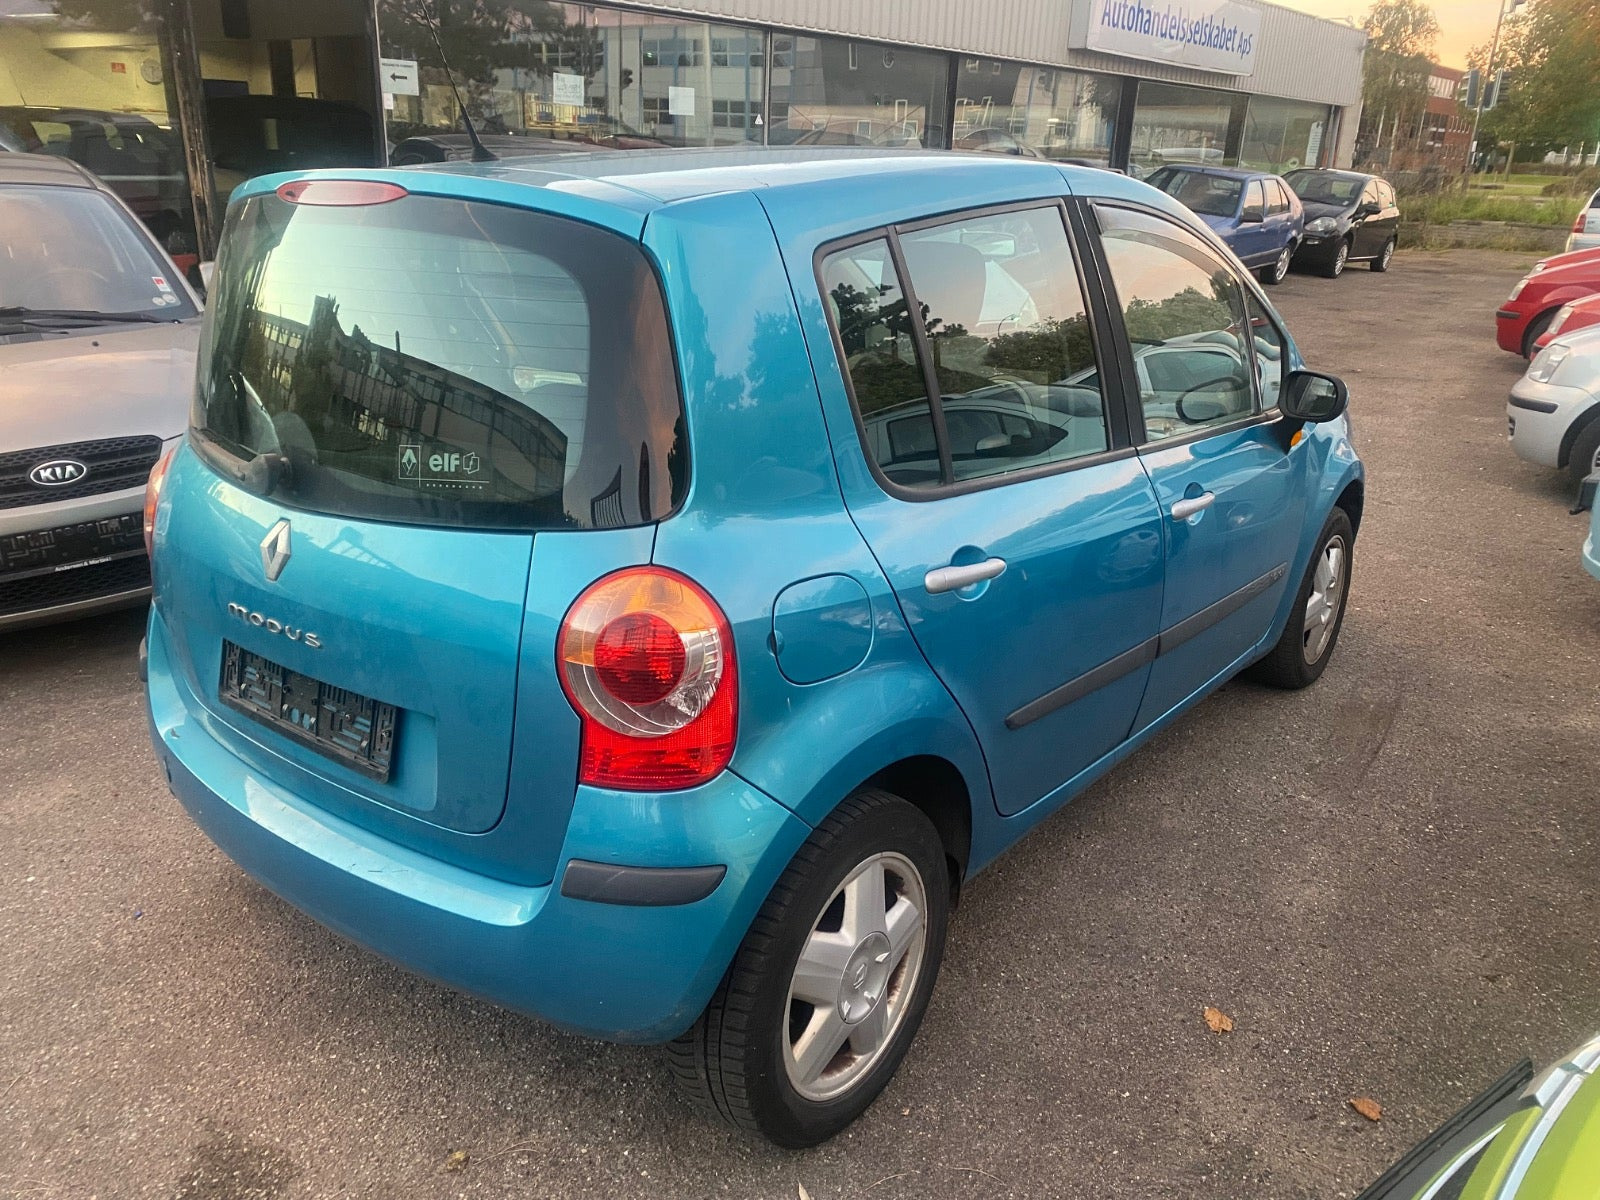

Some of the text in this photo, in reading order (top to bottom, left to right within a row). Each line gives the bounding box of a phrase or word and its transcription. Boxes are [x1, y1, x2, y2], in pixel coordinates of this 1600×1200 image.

[1101, 0, 1253, 60] Autohandelsselskabet ApS
[429, 453, 460, 472] elf
[39, 465, 79, 481] KIA
